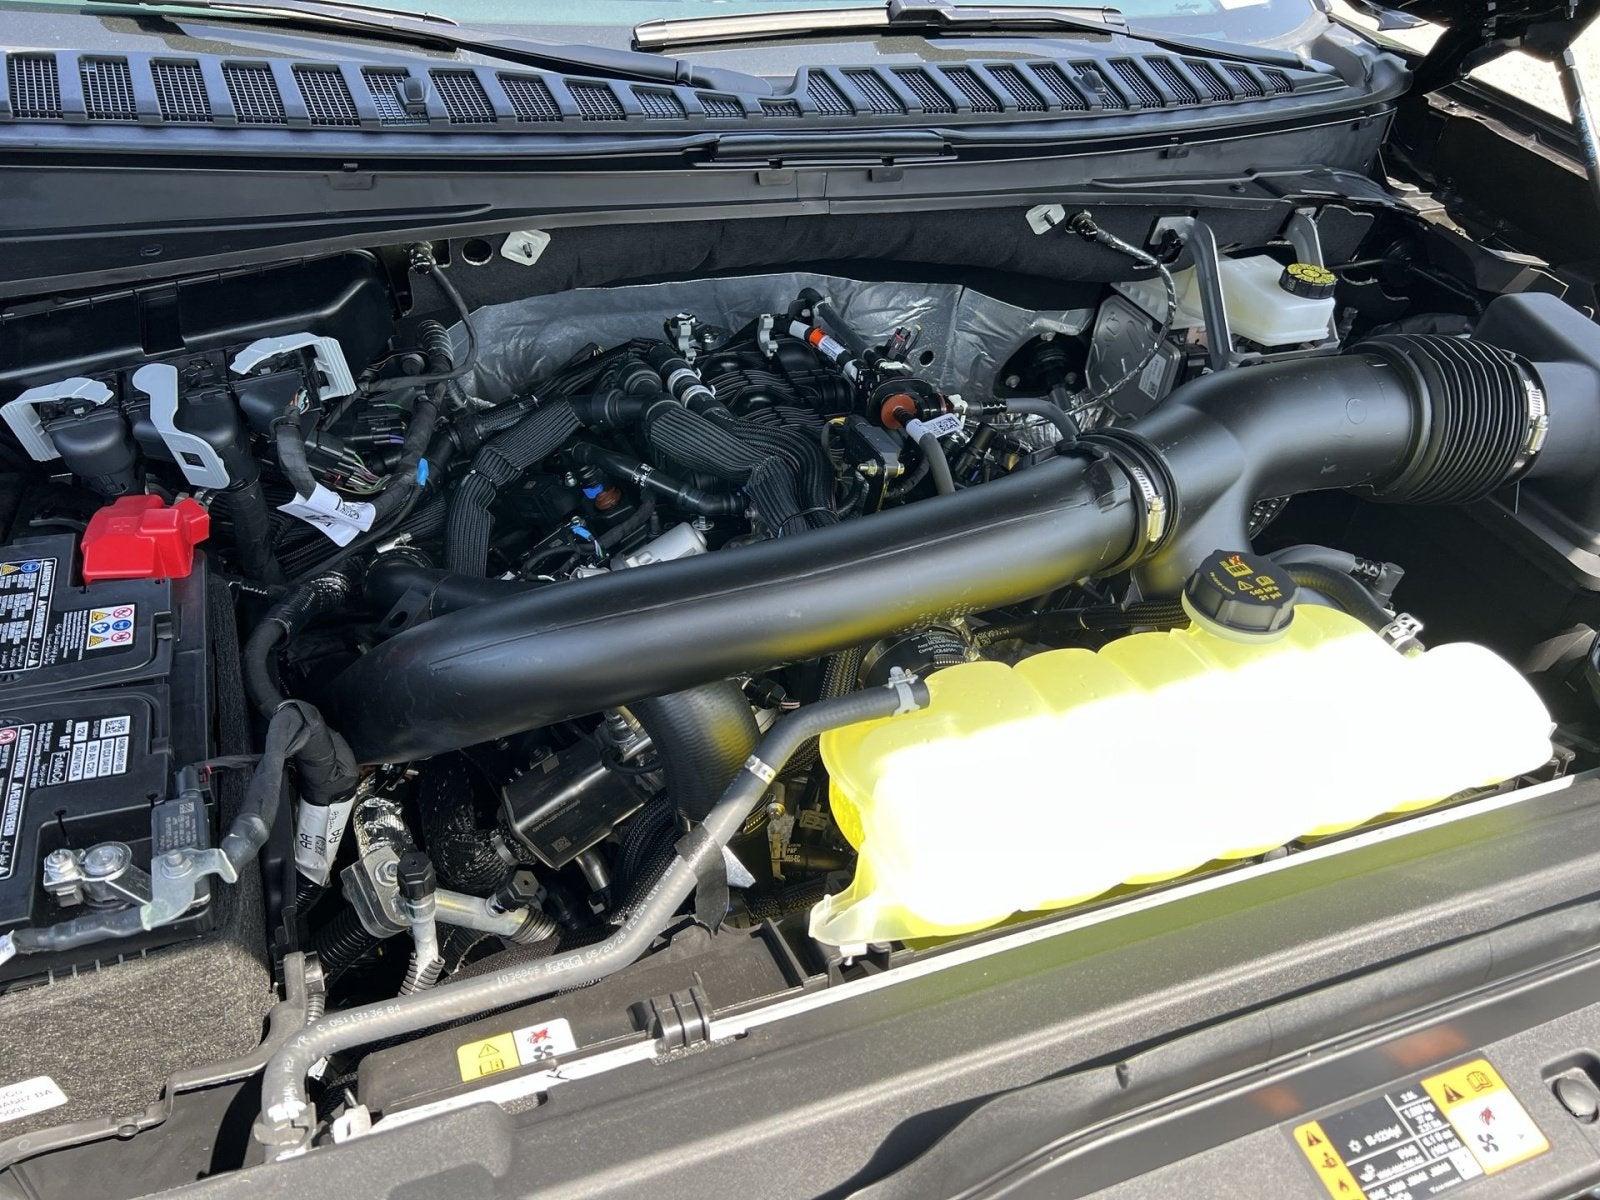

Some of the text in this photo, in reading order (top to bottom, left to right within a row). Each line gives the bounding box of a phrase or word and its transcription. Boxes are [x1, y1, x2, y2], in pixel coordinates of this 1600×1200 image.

[76, 726, 86, 737] 12V
[59, 735, 71, 749] MF
[52, 753, 66, 783] FoMoCo
[300, 833, 313, 849] AA
[328, 828, 343, 843] AA
